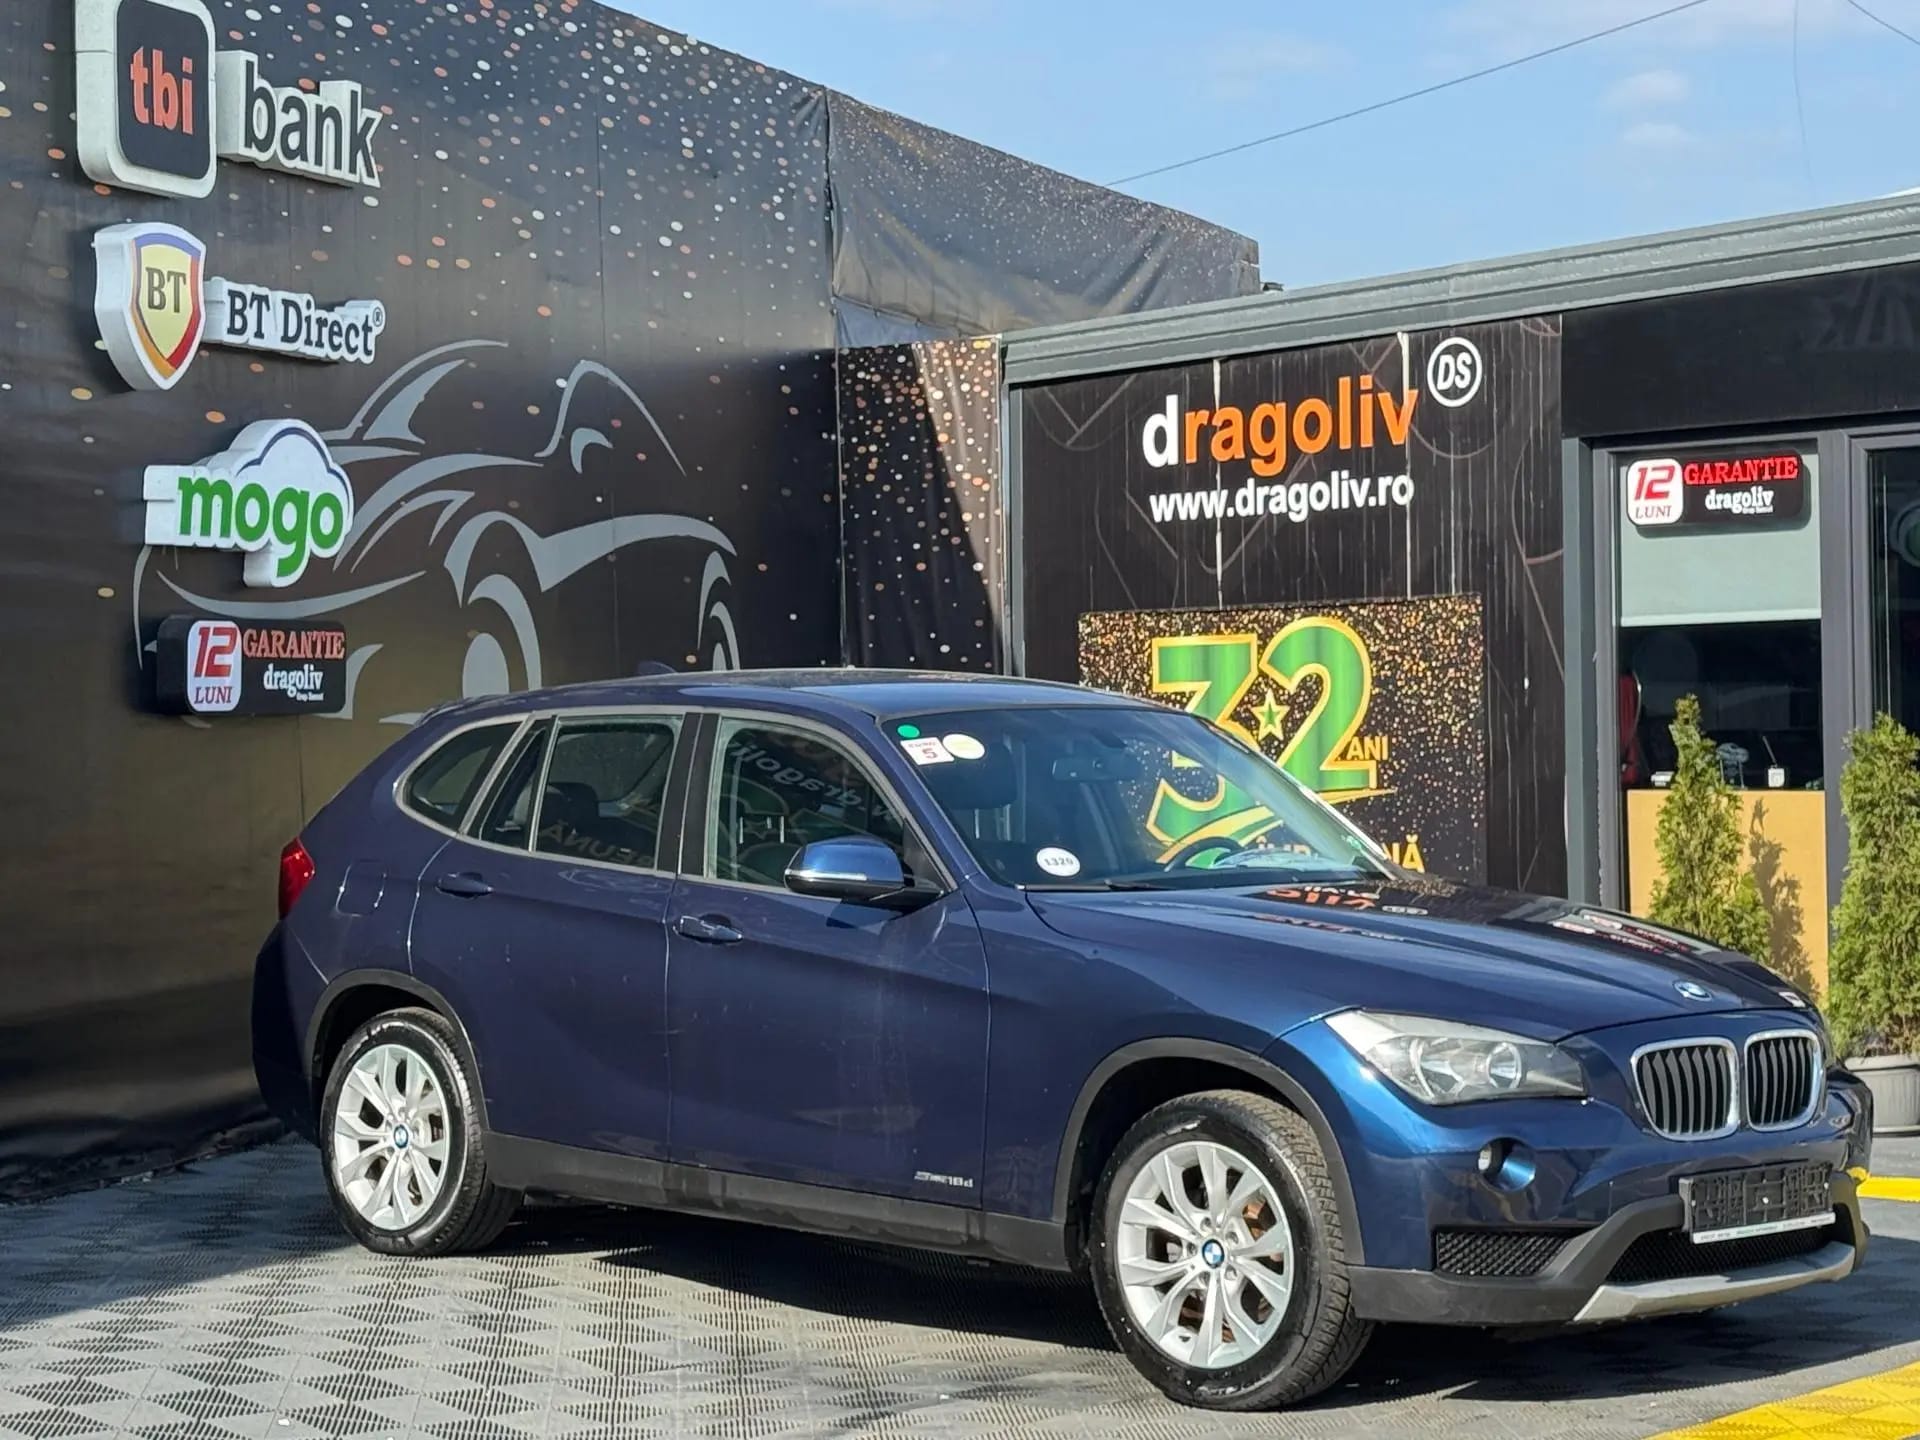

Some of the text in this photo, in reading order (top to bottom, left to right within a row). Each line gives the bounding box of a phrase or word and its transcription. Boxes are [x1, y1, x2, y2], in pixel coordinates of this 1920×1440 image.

[129, 46, 378, 179] tbi bank
[145, 266, 188, 314] BT
[226, 288, 271, 340] BT
[1436, 351, 1473, 391] DS
[1141, 374, 1419, 477] dragoliv
[1634, 464, 1676, 501] 12
[1683, 455, 1799, 486] GARANTIE
[1149, 469, 1415, 523] www.dragoliv.ro
[1635, 504, 1673, 520] LUNI
[1704, 486, 1775, 515] dragoliv
[177, 476, 344, 578] mogo
[193, 626, 238, 679] 12
[243, 628, 346, 660] GARANTIE
[194, 686, 233, 705] LUNI
[263, 662, 324, 699] dragoliv
[1146, 615, 1377, 843] 32
[922, 747, 938, 759] 5
[1346, 736, 1389, 761] ANI
